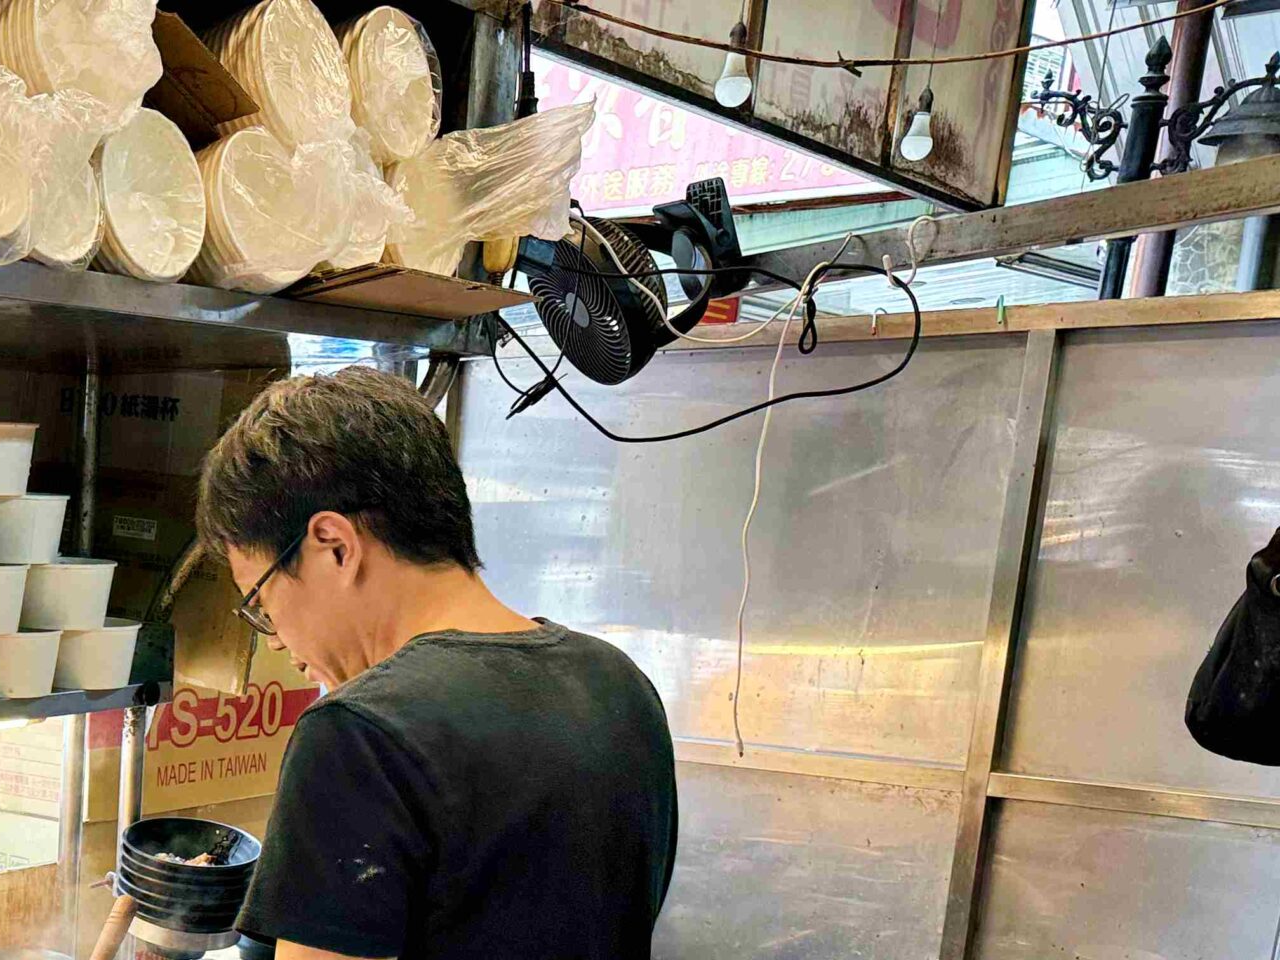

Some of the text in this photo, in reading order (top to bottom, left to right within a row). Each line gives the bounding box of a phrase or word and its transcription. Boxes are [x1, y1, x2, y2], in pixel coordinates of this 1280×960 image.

[156, 751, 268, 787] MADE IN TAIWAN
